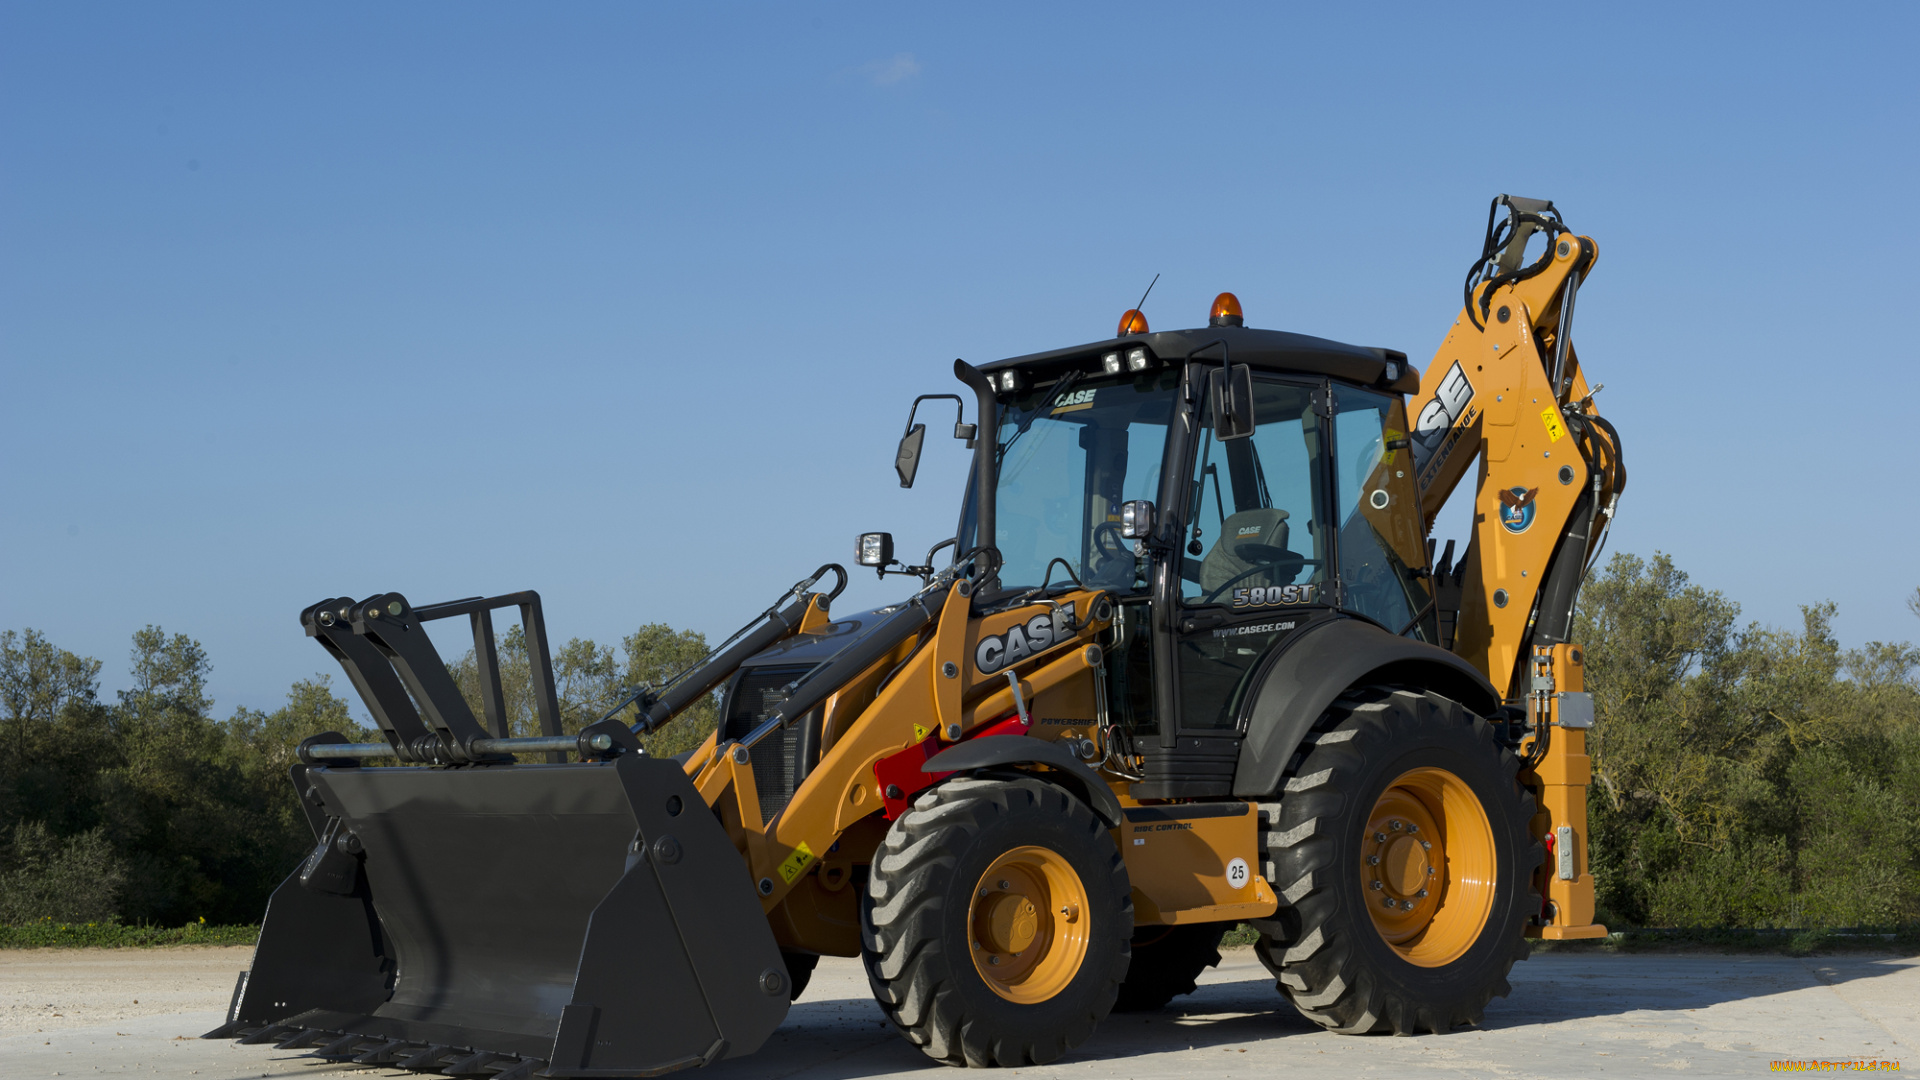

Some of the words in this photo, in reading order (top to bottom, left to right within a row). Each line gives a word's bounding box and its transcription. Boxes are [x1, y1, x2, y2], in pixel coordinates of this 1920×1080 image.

[1054, 388, 1097, 408] CASE
[1420, 404, 1478, 492] EXTENDAHOE
[1238, 525, 1262, 536] CASE
[1232, 584, 1316, 608] 580ST
[975, 600, 1077, 675] CASE
[1212, 621, 1296, 638] WWW.CASECE.COM
[1040, 717, 1098, 726] POWERSHIFT
[1133, 824, 1154, 833] RIDE
[1155, 822, 1194, 832] CONTROL
[1231, 865, 1244, 879] 25
